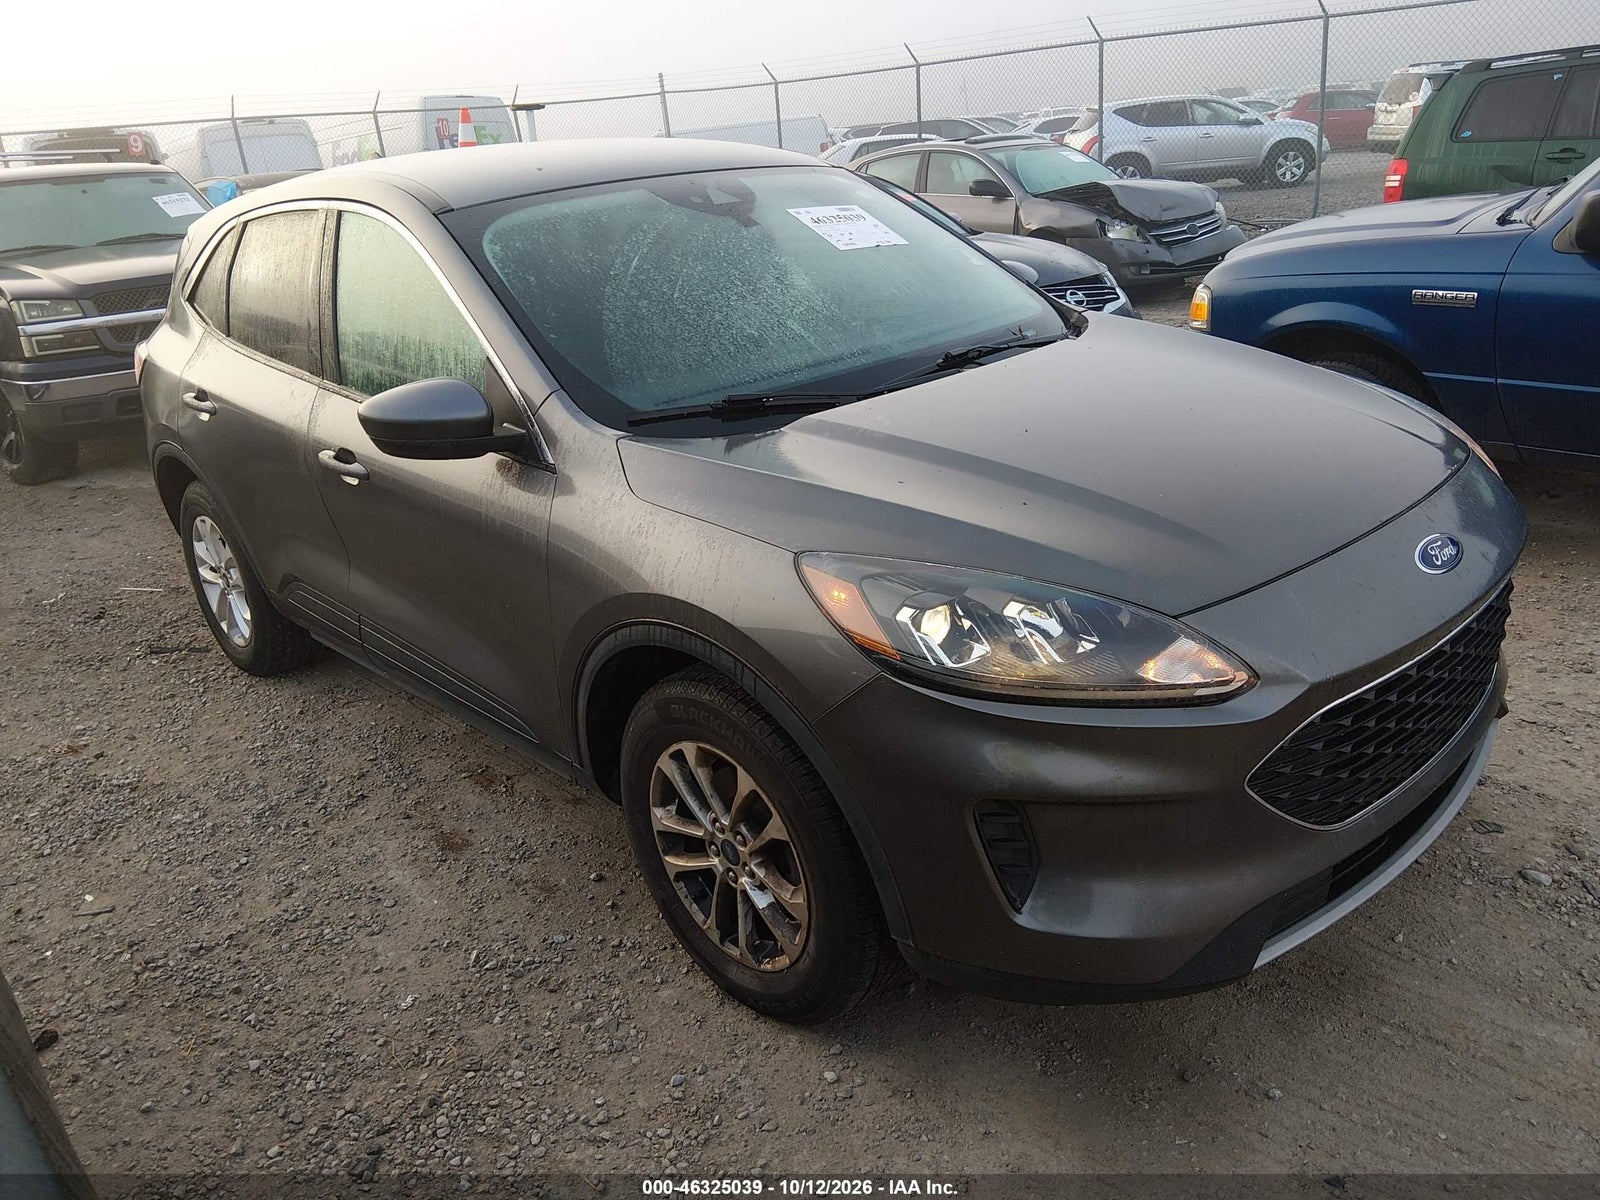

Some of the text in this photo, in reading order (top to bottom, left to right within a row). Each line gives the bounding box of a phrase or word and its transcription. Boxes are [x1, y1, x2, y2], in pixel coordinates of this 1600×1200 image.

[438, 120, 449, 136] 10
[131, 135, 144, 153] 9
[1412, 290, 1477, 302] RANGER
